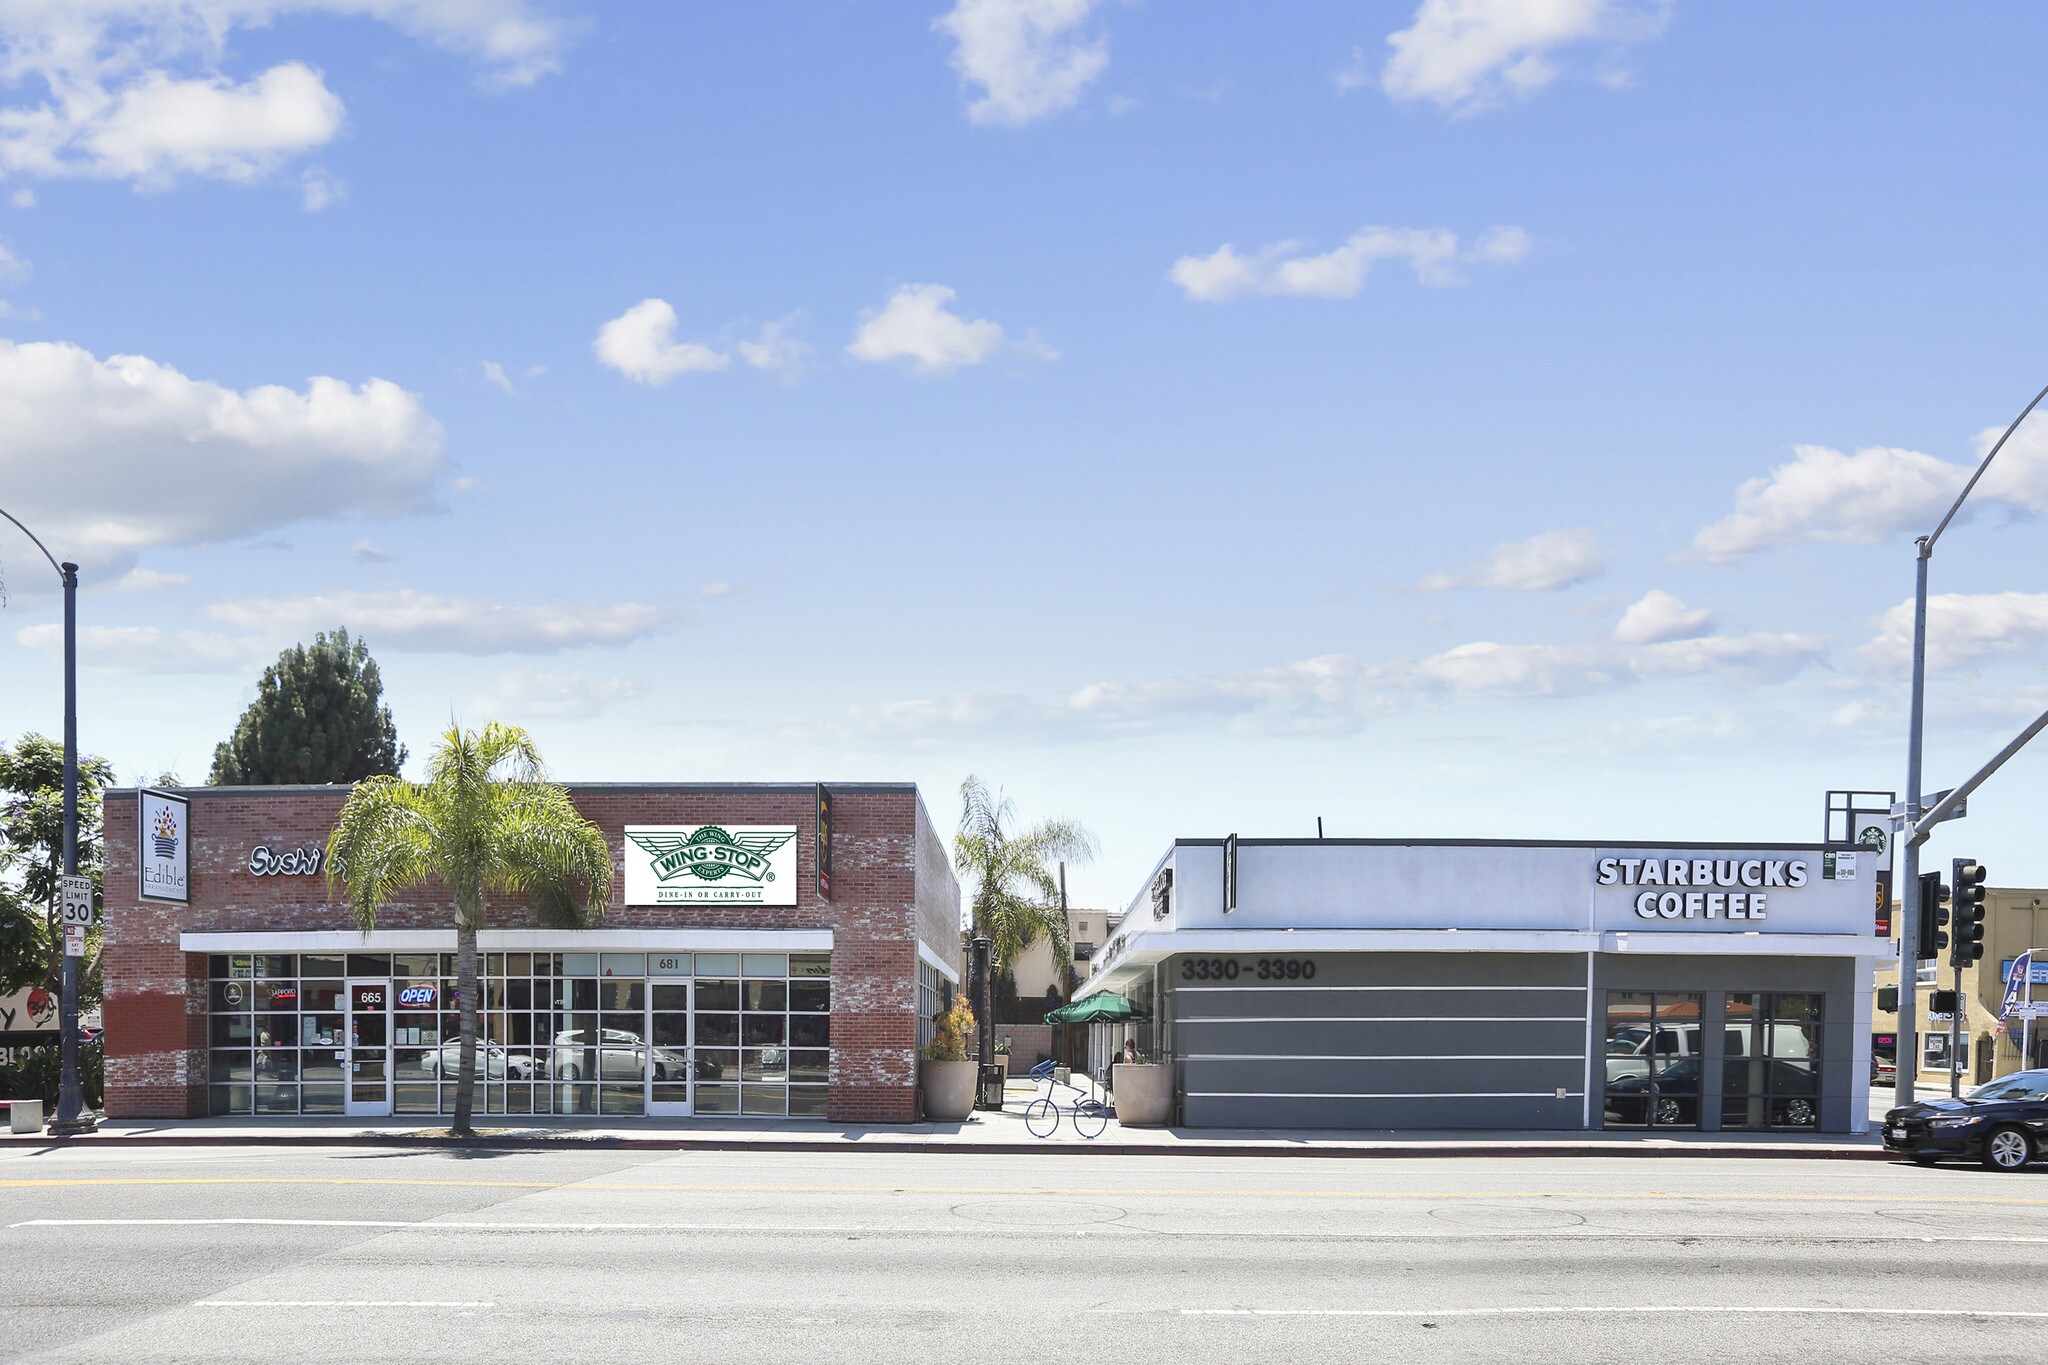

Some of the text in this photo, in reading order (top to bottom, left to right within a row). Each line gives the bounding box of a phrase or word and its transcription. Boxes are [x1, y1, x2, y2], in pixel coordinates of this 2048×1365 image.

[696, 831, 725, 843] THE WING
[249, 846, 320, 876] Sushi
[145, 864, 184, 887] Edible
[697, 866, 725, 876] EXPERTS
[1597, 857, 1808, 888] STARBUCKS
[63, 880, 90, 890] SPEED
[66, 892, 88, 901] LIMIT
[1634, 891, 1768, 919] COFFEE
[65, 902, 89, 921] 30
[659, 958, 678, 969] 681
[271, 988, 296, 996] SAPPORO
[361, 992, 381, 1003] 665
[400, 989, 434, 1002] OPEN
